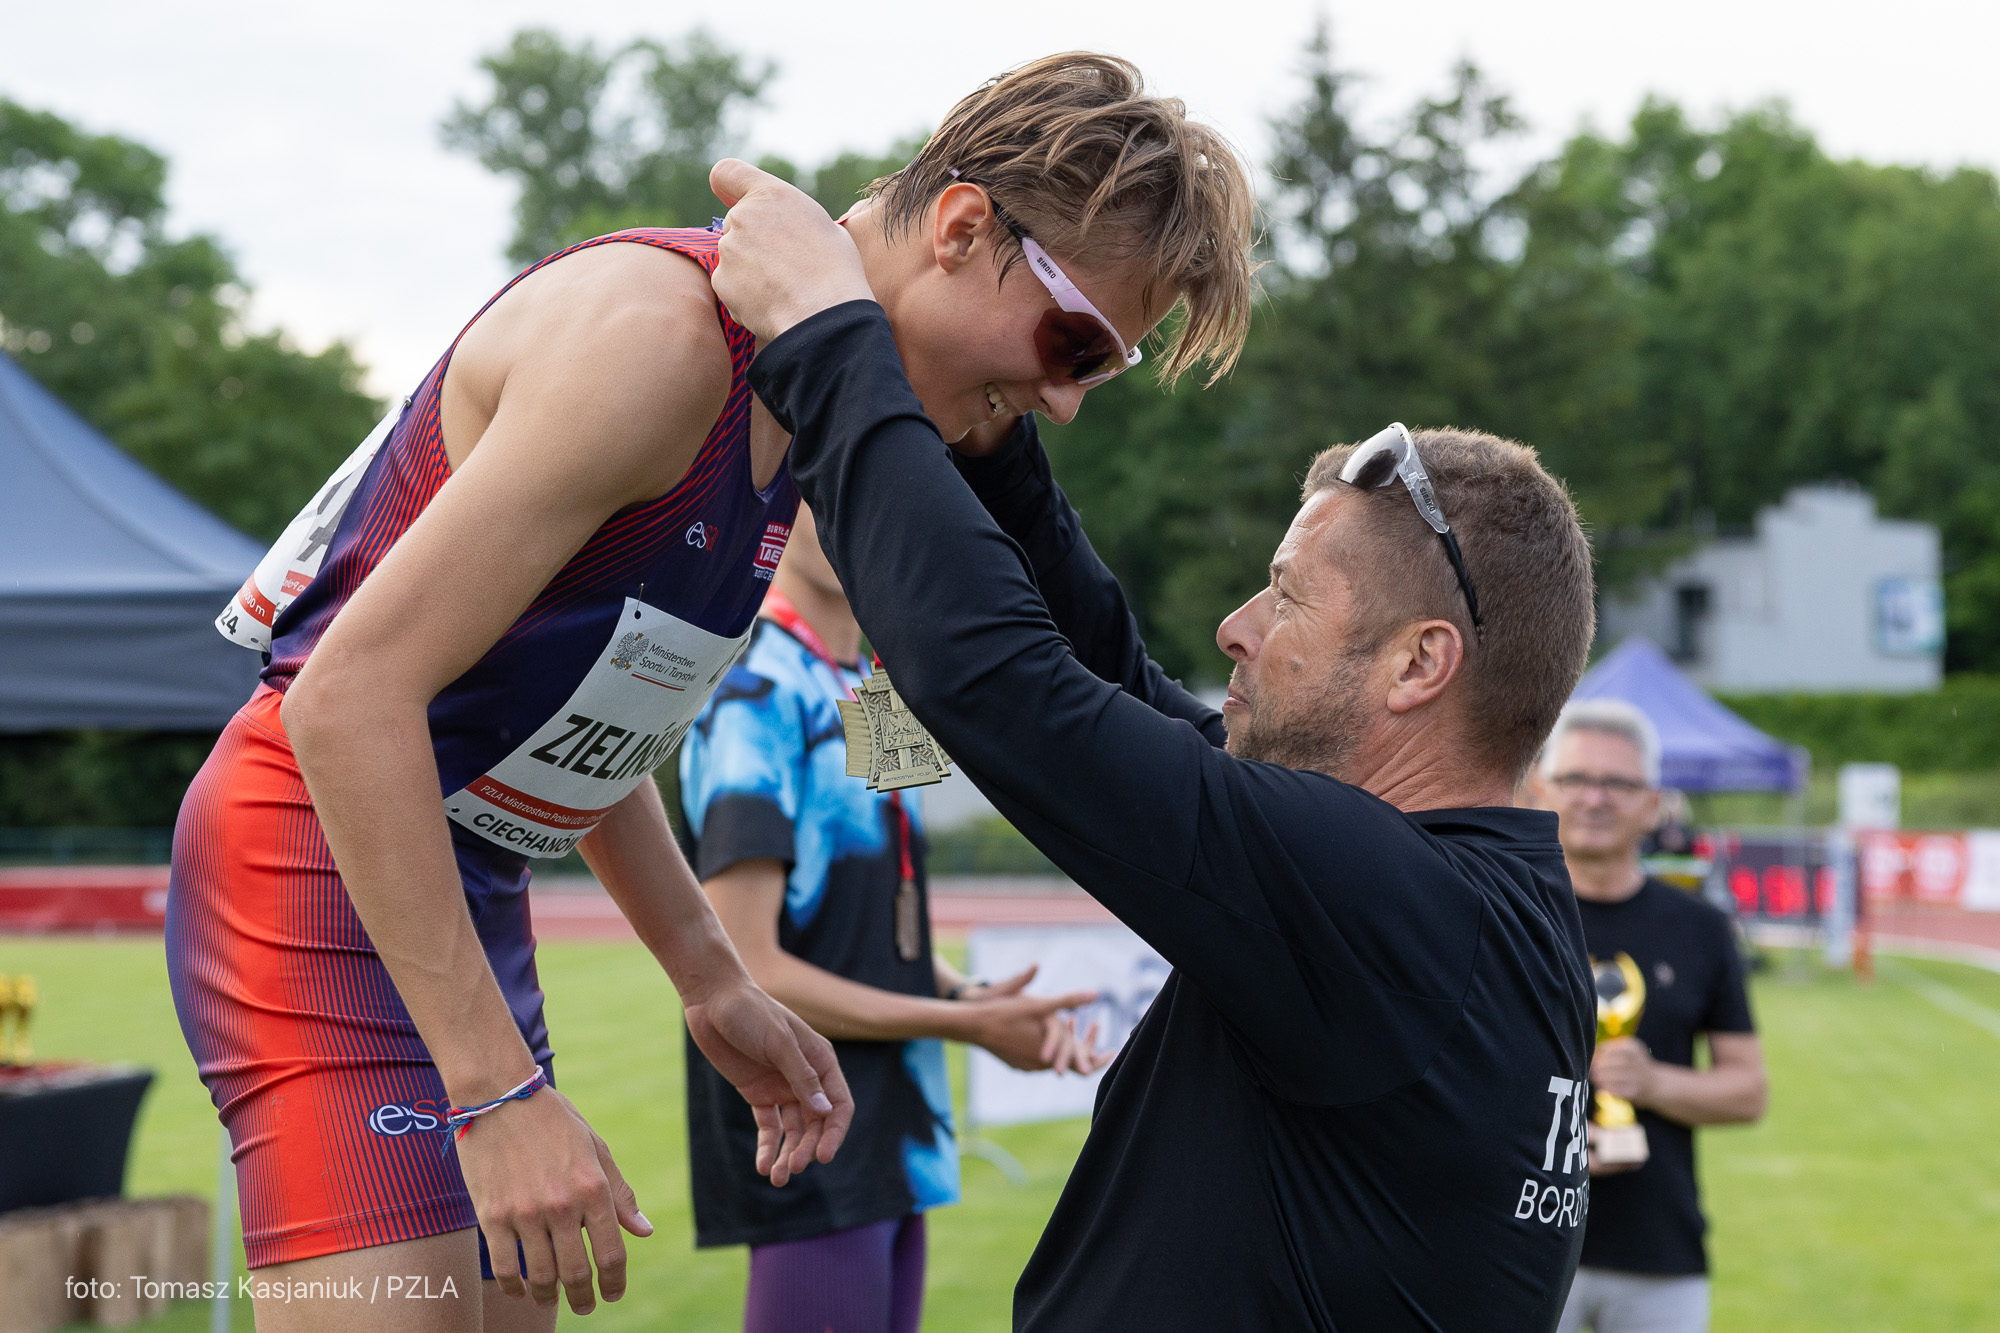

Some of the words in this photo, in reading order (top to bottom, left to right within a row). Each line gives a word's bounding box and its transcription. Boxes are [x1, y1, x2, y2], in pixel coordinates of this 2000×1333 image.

[1037, 256, 1056, 279] SIROKO
[1420, 487, 1436, 512] SIROKO
[255, 607, 266, 617] m
[648, 643, 696, 668] Ministerstwo
[639, 656, 666, 674] Sportu
[669, 667, 698, 682] Turystyki
[884, 732, 922, 748] PZLA
[480, 785, 504, 801] PZLA
[502, 796, 551, 819] Mistrzostwa
[549, 813, 573, 824] Polski
